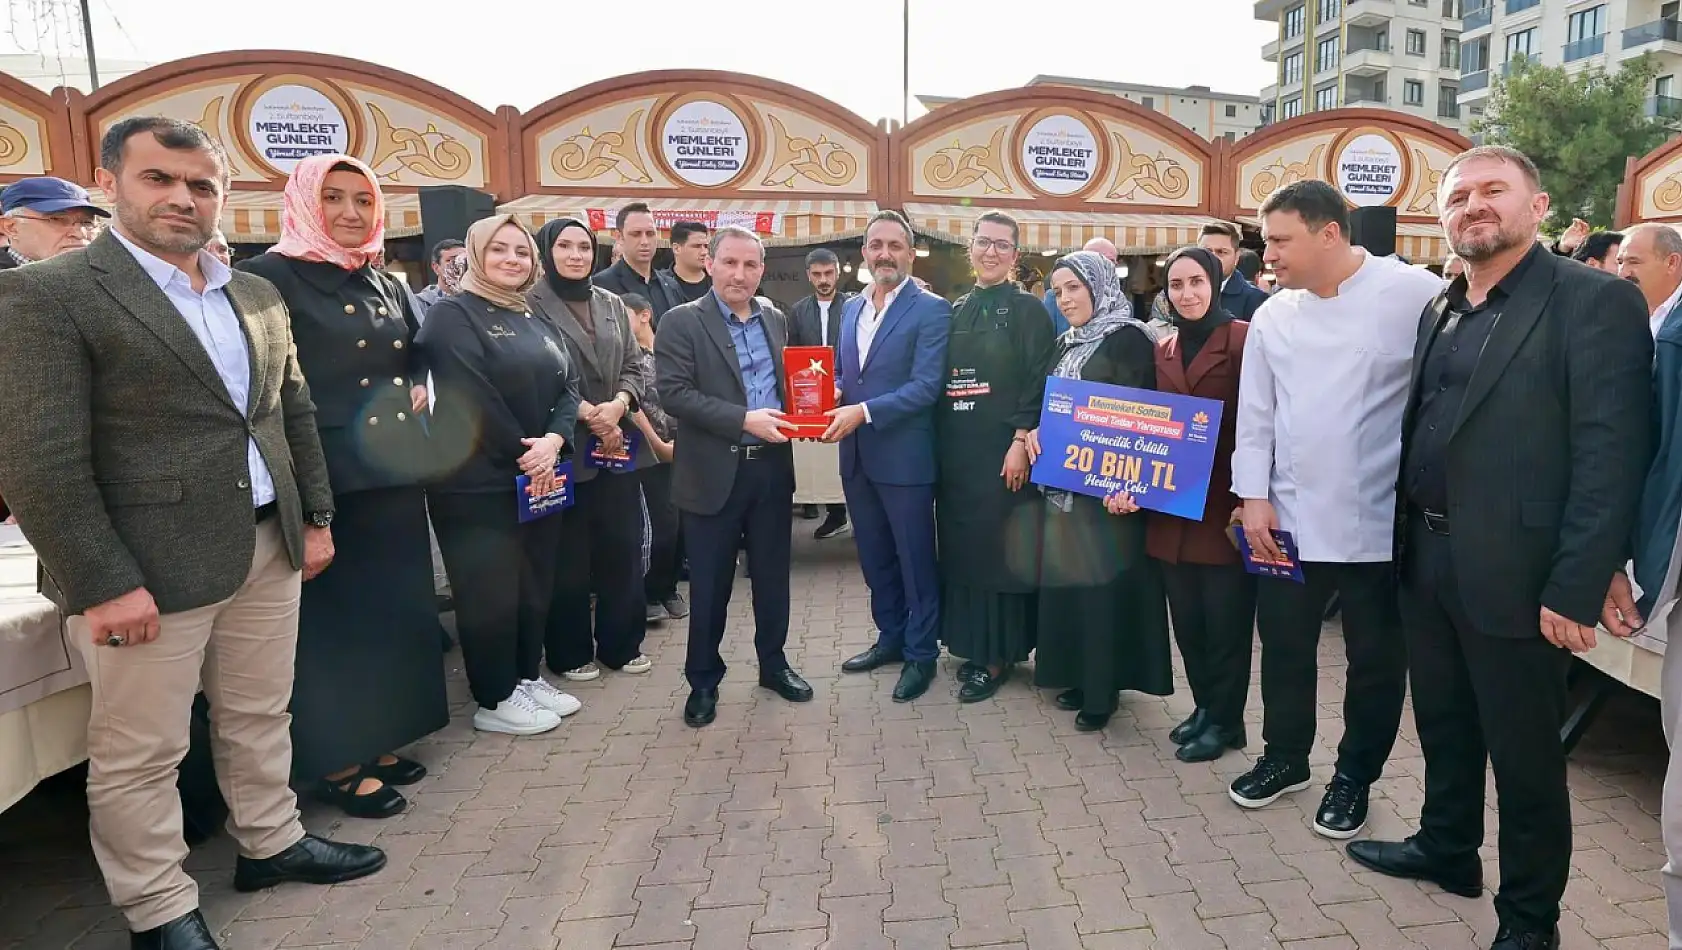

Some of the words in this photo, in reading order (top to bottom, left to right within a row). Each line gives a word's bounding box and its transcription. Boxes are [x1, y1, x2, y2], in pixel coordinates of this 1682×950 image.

[256, 122, 339, 134] MEMLEKET
[668, 135, 742, 146] MEMLEKET
[1028, 145, 1093, 158] MEMLEKET
[1341, 163, 1397, 174] MEMLEKET
[1090, 397, 1135, 414] Memleket
[1077, 410, 1108, 423] Yöresel
[1110, 415, 1135, 428] Tatlar
[1080, 429, 1132, 449] Birincilik
[1063, 444, 1094, 472] 20
[1151, 460, 1177, 491] TL
[1084, 474, 1121, 493] Hediye
